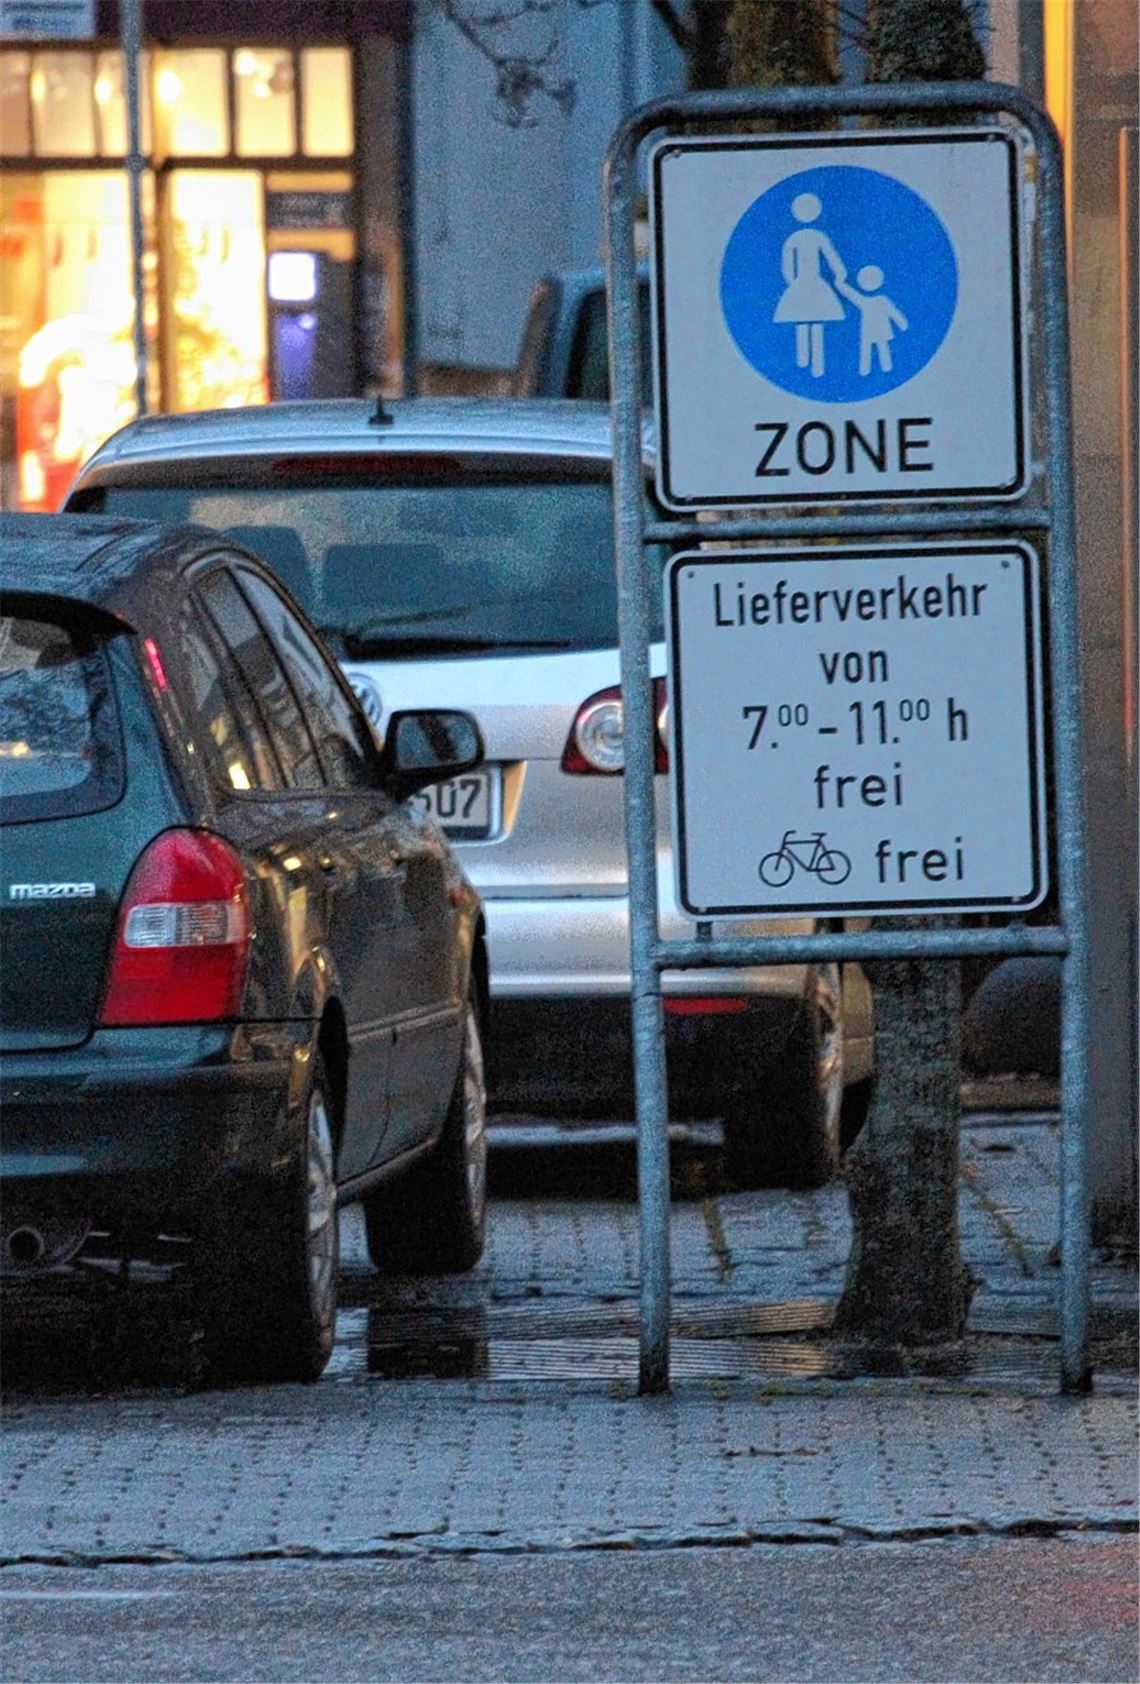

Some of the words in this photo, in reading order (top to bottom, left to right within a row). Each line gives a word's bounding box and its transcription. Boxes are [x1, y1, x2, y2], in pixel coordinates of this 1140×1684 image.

[755, 418, 933, 477] ZONE
[714, 573, 987, 626] Lieferverkehr
[820, 651, 888, 684] von
[948, 698, 967, 741] h
[814, 762, 901, 808] frei
[875, 837, 963, 883] frei
[9, 882, 96, 900] mazda
